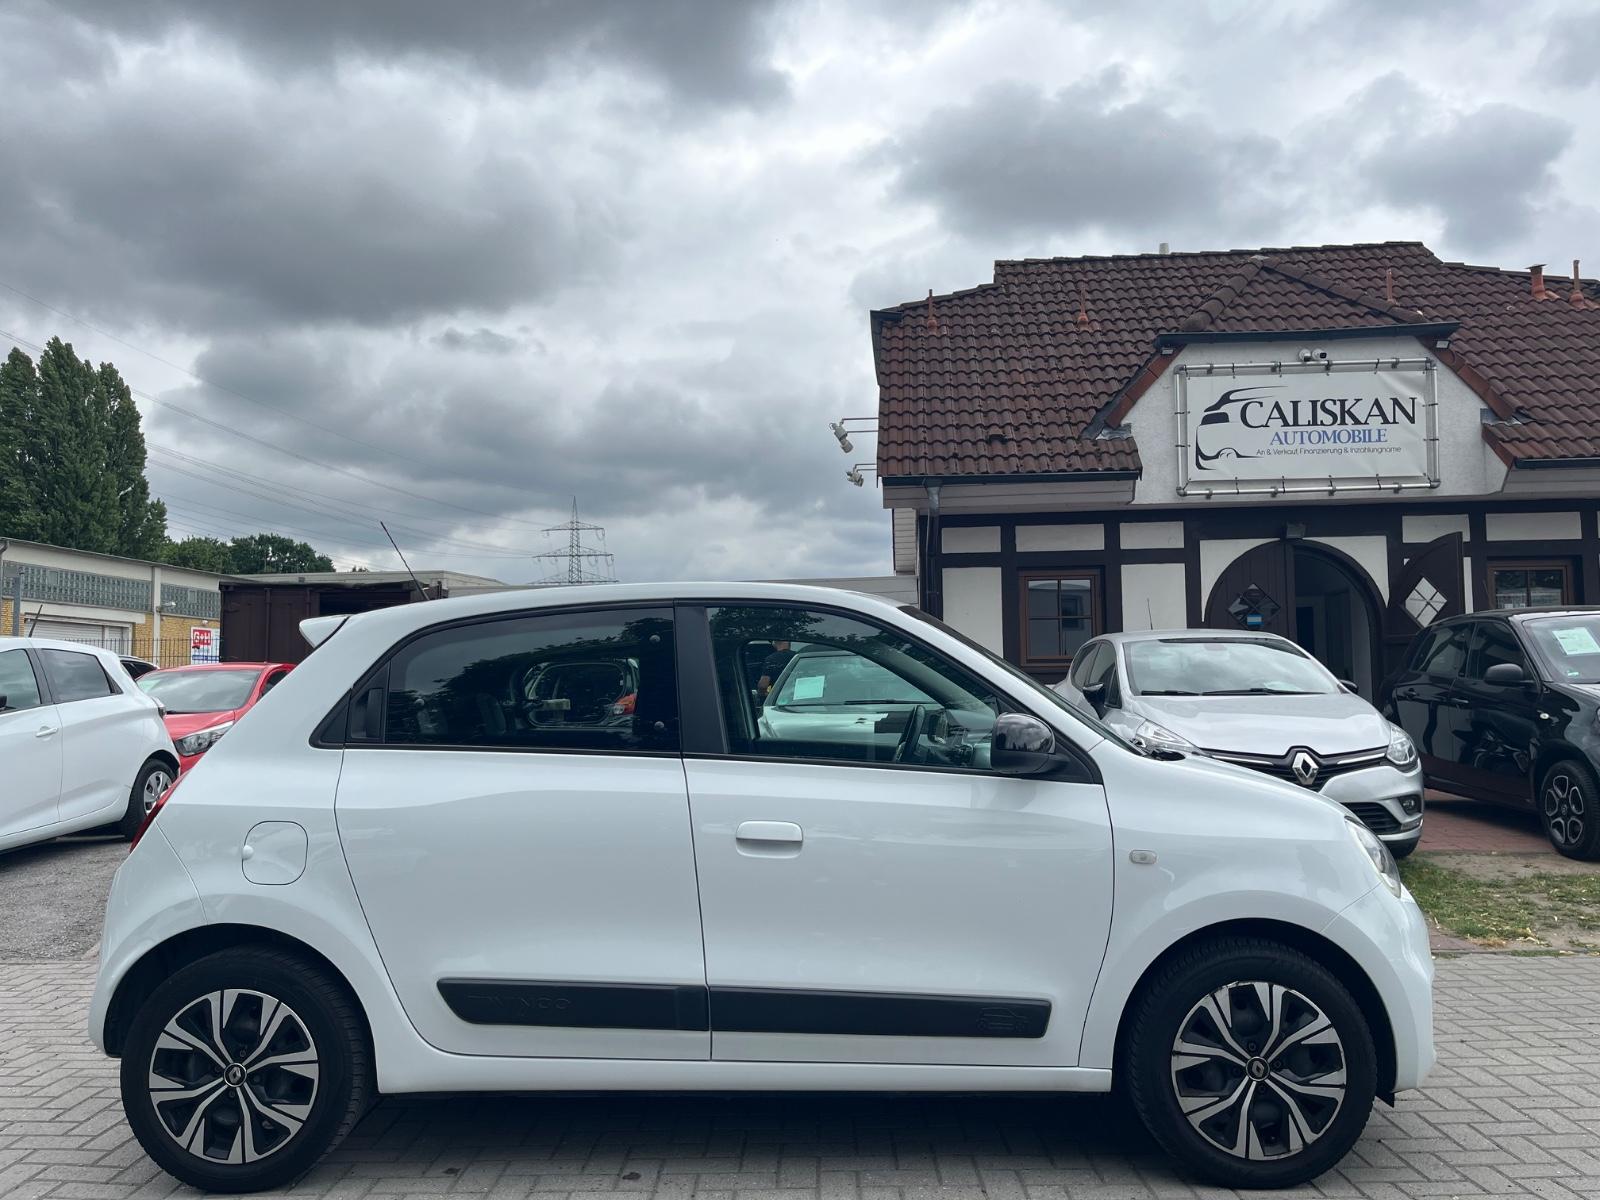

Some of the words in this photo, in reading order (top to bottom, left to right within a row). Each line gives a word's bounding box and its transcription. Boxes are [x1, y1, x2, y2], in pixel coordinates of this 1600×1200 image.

[1240, 396, 1418, 429] CALISKAN
[1270, 428, 1388, 446] AUTOMOBILE
[1256, 448, 1266, 456] An
[1266, 448, 1272, 456] &
[1299, 447, 1343, 456] Finanzierung
[1343, 446, 1350, 454] &
